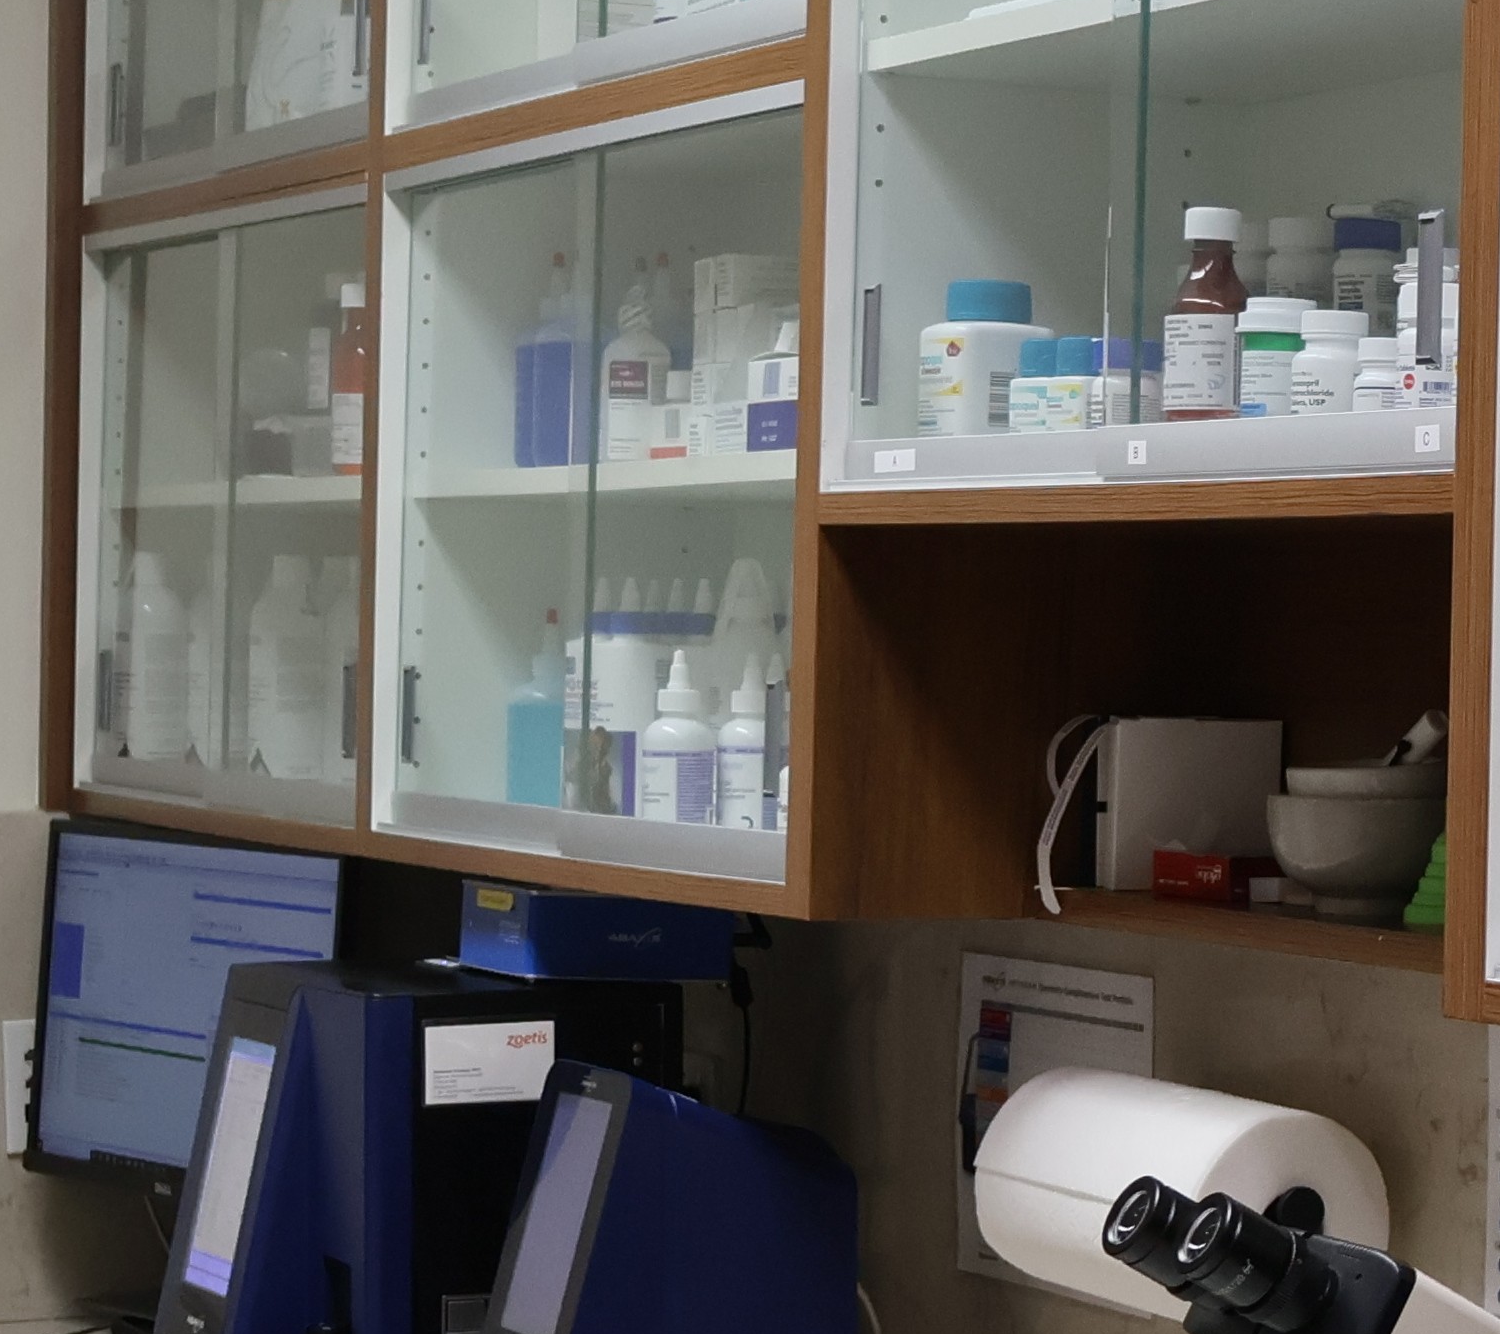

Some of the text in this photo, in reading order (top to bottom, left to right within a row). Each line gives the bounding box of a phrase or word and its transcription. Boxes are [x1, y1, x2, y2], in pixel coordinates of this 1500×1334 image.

[1308, 398, 1327, 407] USP
[1422, 431, 1431, 446] C
[1131, 445, 1140, 460] B
[506, 1030, 548, 1049] zoetis
